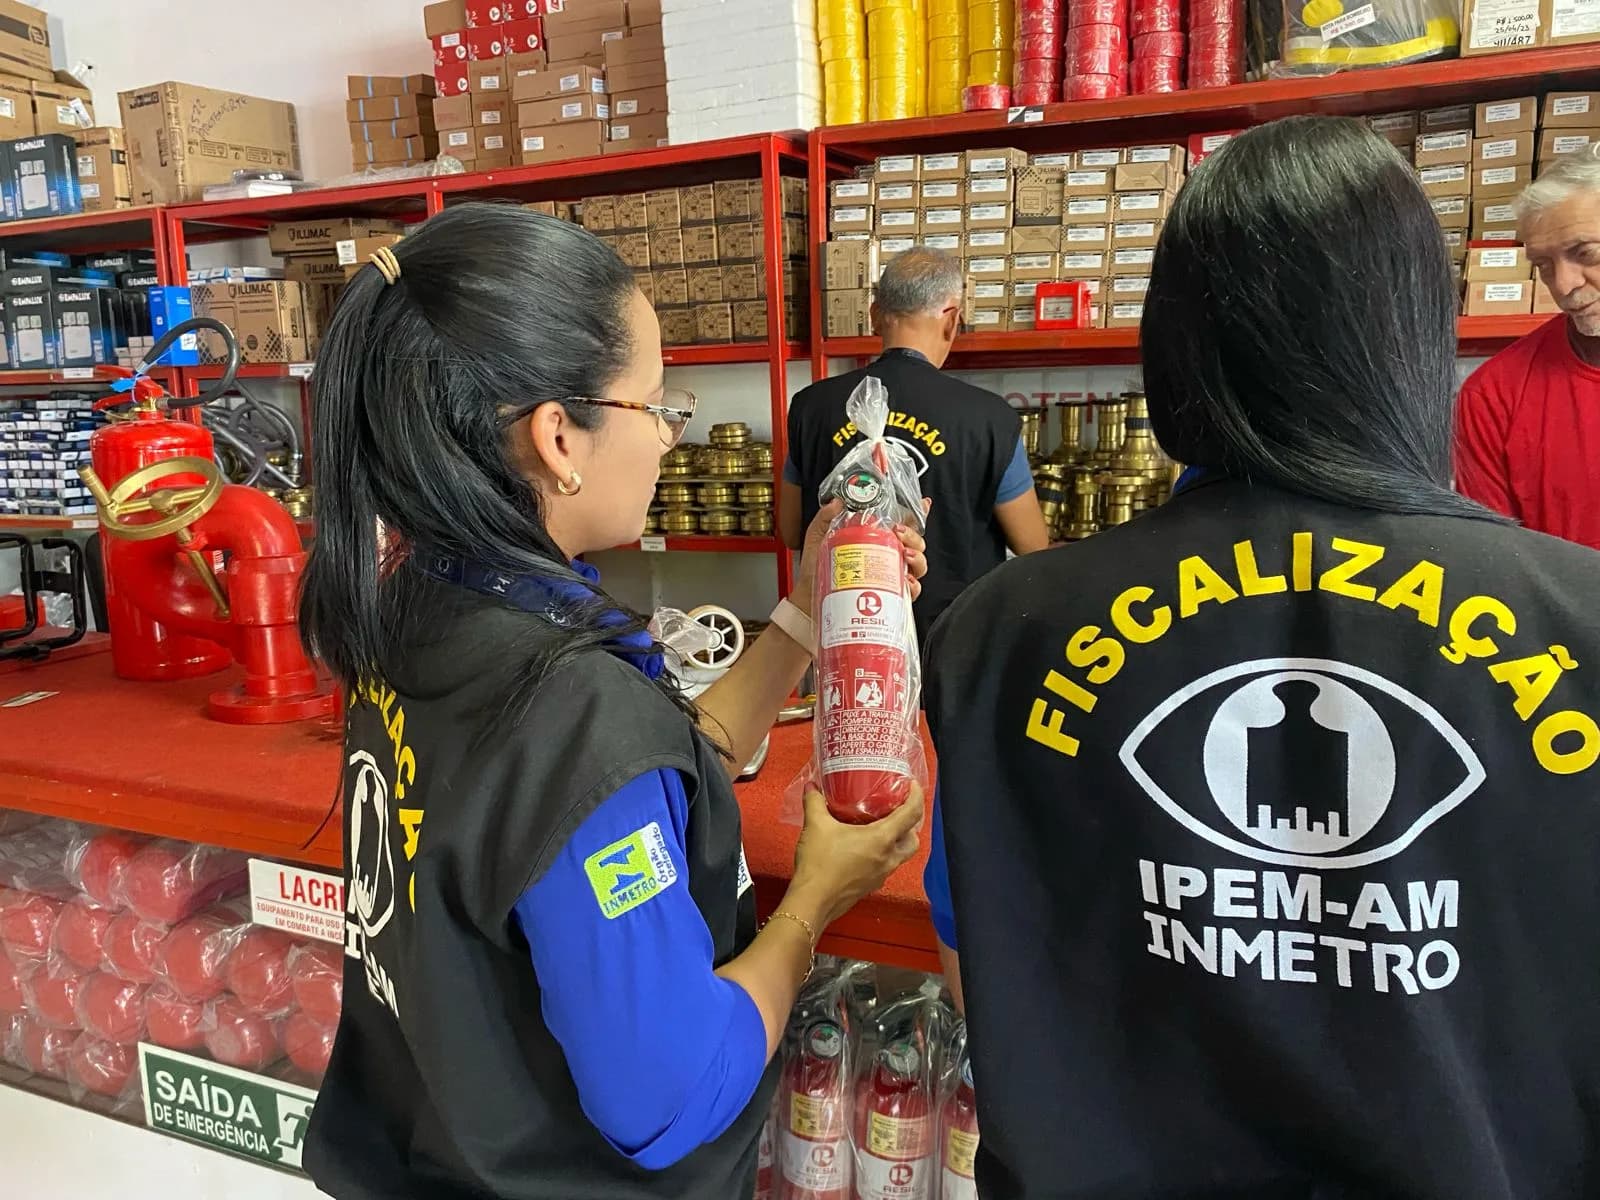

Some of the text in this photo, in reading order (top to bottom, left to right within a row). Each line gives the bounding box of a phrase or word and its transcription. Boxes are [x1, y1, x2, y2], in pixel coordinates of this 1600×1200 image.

[236, 282, 273, 294] ILUMAC
[833, 412, 946, 455] FISIZAÇÃO
[851, 617, 888, 626] RESIL
[1026, 532, 1600, 775] FISCALIZAÇÃO
[256, 902, 340, 929] EQUIPAMENTO PARA USO
[602, 876, 658, 915] INMETRO
[1138, 859, 1459, 931] IPEM-AM
[286, 919, 319, 935] COMBATE
[1143, 911, 1460, 995] INMETRO
[155, 1070, 262, 1128] SAÍDA
[154, 1102, 270, 1154] DE EMERGÊNCIA
